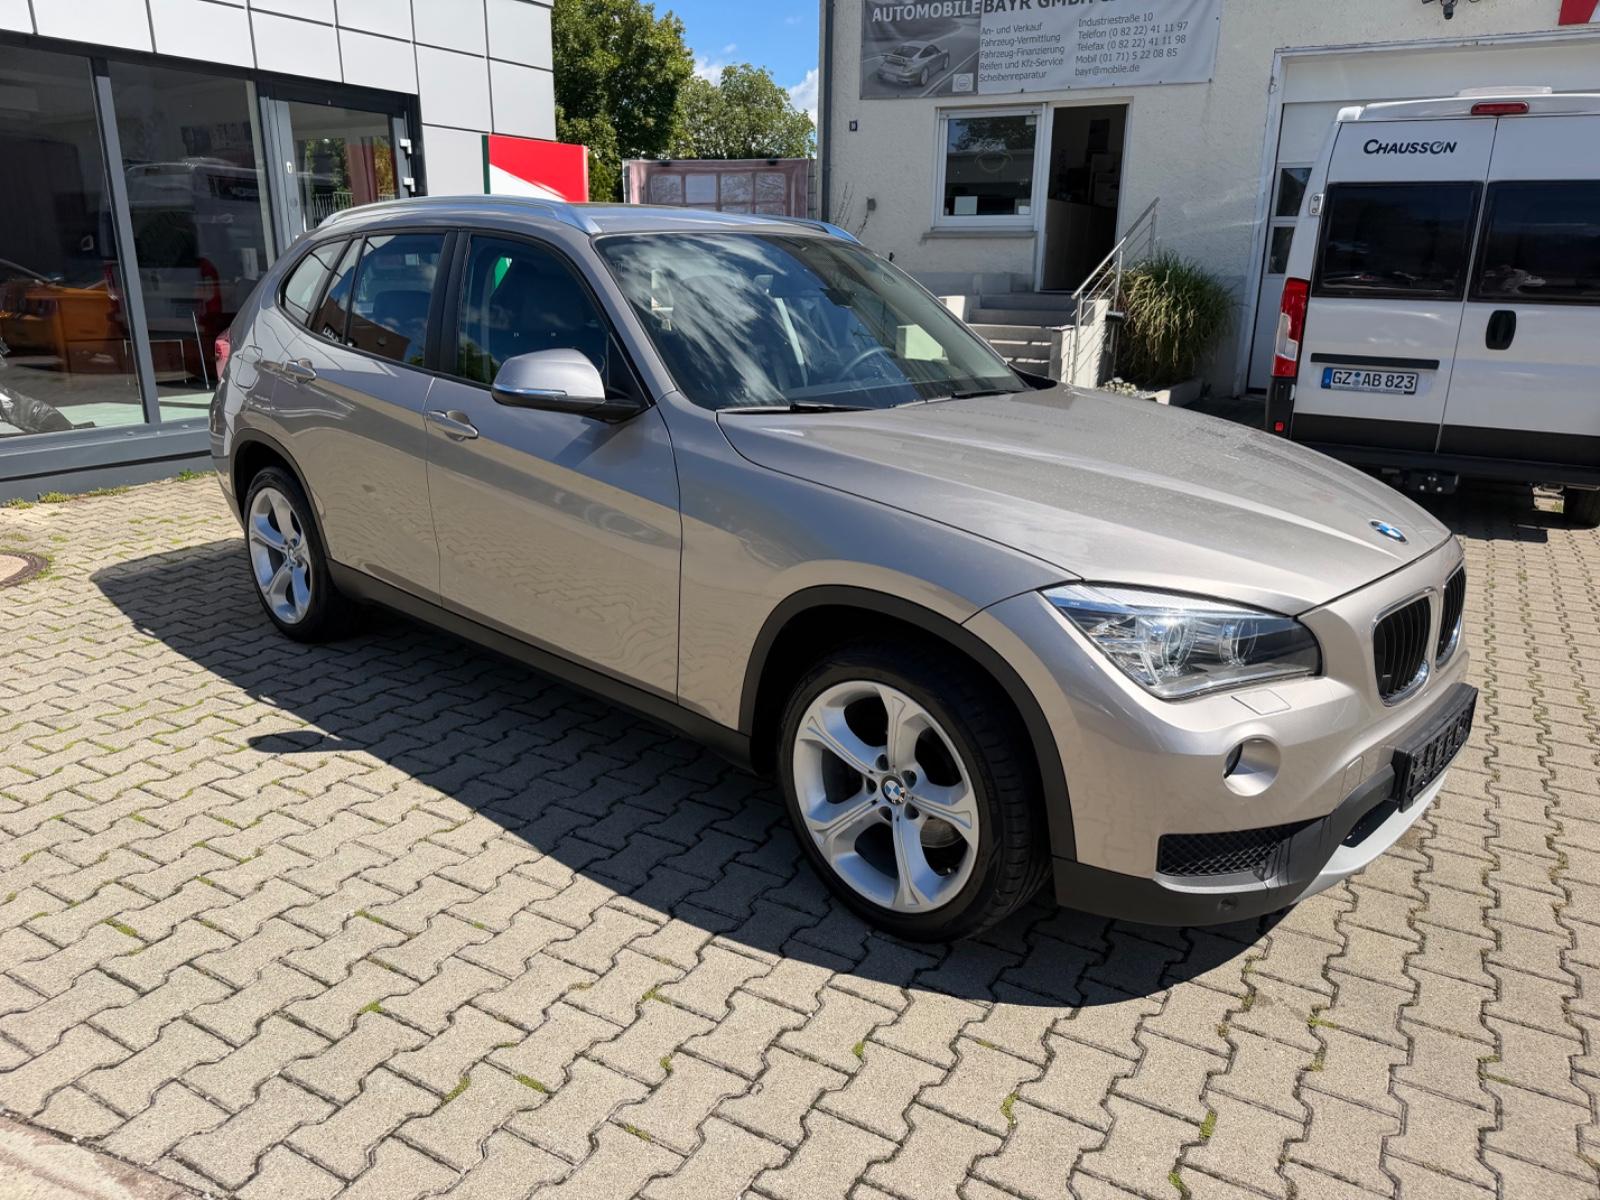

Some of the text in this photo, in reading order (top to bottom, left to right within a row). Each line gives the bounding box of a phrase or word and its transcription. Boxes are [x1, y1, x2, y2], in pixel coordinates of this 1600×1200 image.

[872, 1, 981, 22] AUTOMOBILE
[983, 0, 1032, 13] BAYR
[1143, 12, 1154, 22] 10
[996, 25, 1011, 34] und
[1013, 22, 1043, 33] Verkauf
[1078, 21, 1189, 40] Telefon (0 82 22) 41 11 97
[1077, 34, 1186, 52] Telefax (0 82 22) 41 11 98
[1075, 54, 1097, 64] Mobil
[1099, 53, 1112, 64] (01
[1115, 52, 1130, 63] 71)
[1140, 50, 1151, 60] 22
[980, 61, 1003, 71] Reifen
[1004, 60, 1019, 69] und
[1332, 371, 1353, 385] GZ
[1361, 372, 1382, 388] AB
[1385, 374, 1415, 390] 823
